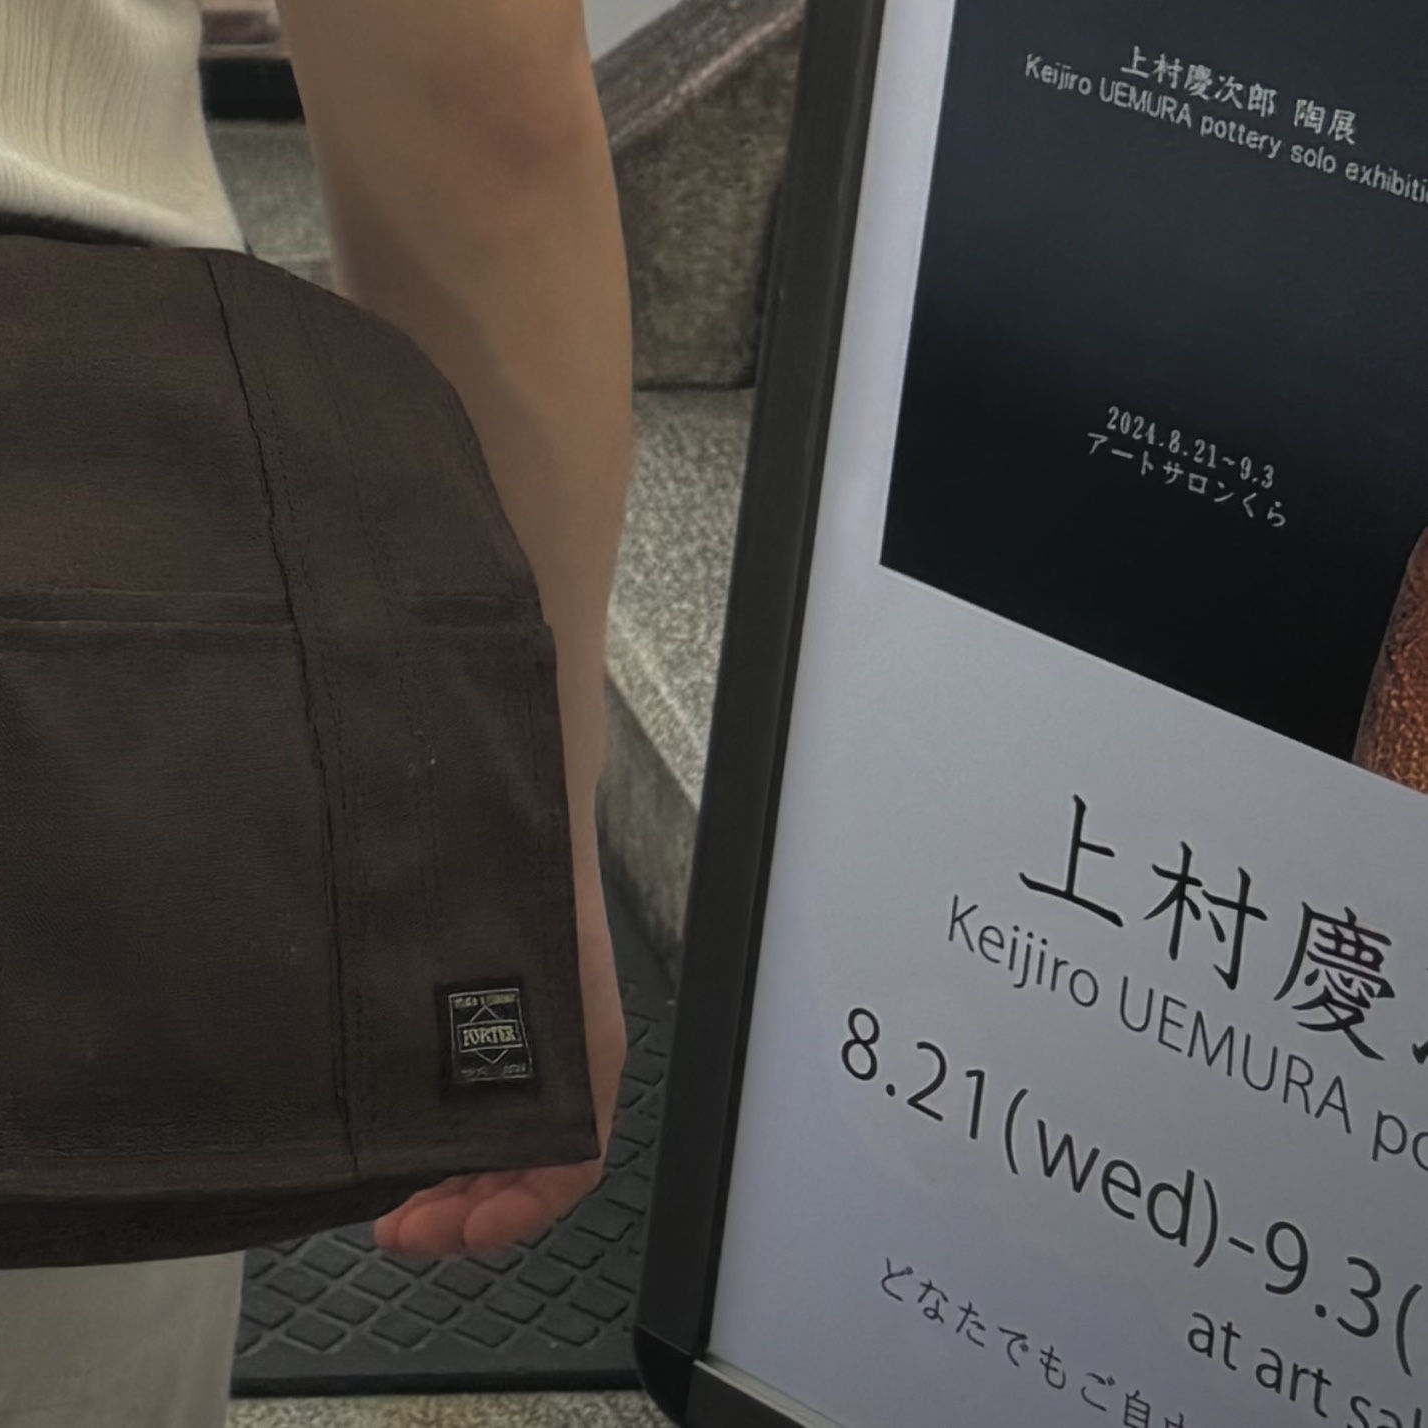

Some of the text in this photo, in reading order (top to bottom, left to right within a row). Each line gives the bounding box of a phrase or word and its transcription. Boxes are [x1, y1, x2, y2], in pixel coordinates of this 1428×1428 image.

[1024, 53, 1428, 204] Keijiro UEMURA pottery solo exhibiti
[1119, 44, 1357, 145] 上村慶次郎 陶展
[1086, 432, 1287, 530] アートサロンくら
[463, 1025, 516, 1046] PORTER
[947, 894, 1100, 1009] Keijiro
[1119, 976, 1352, 1134] UEMURA
[1186, 1310, 1242, 1372] at
[1255, 1346, 1333, 1420] art
